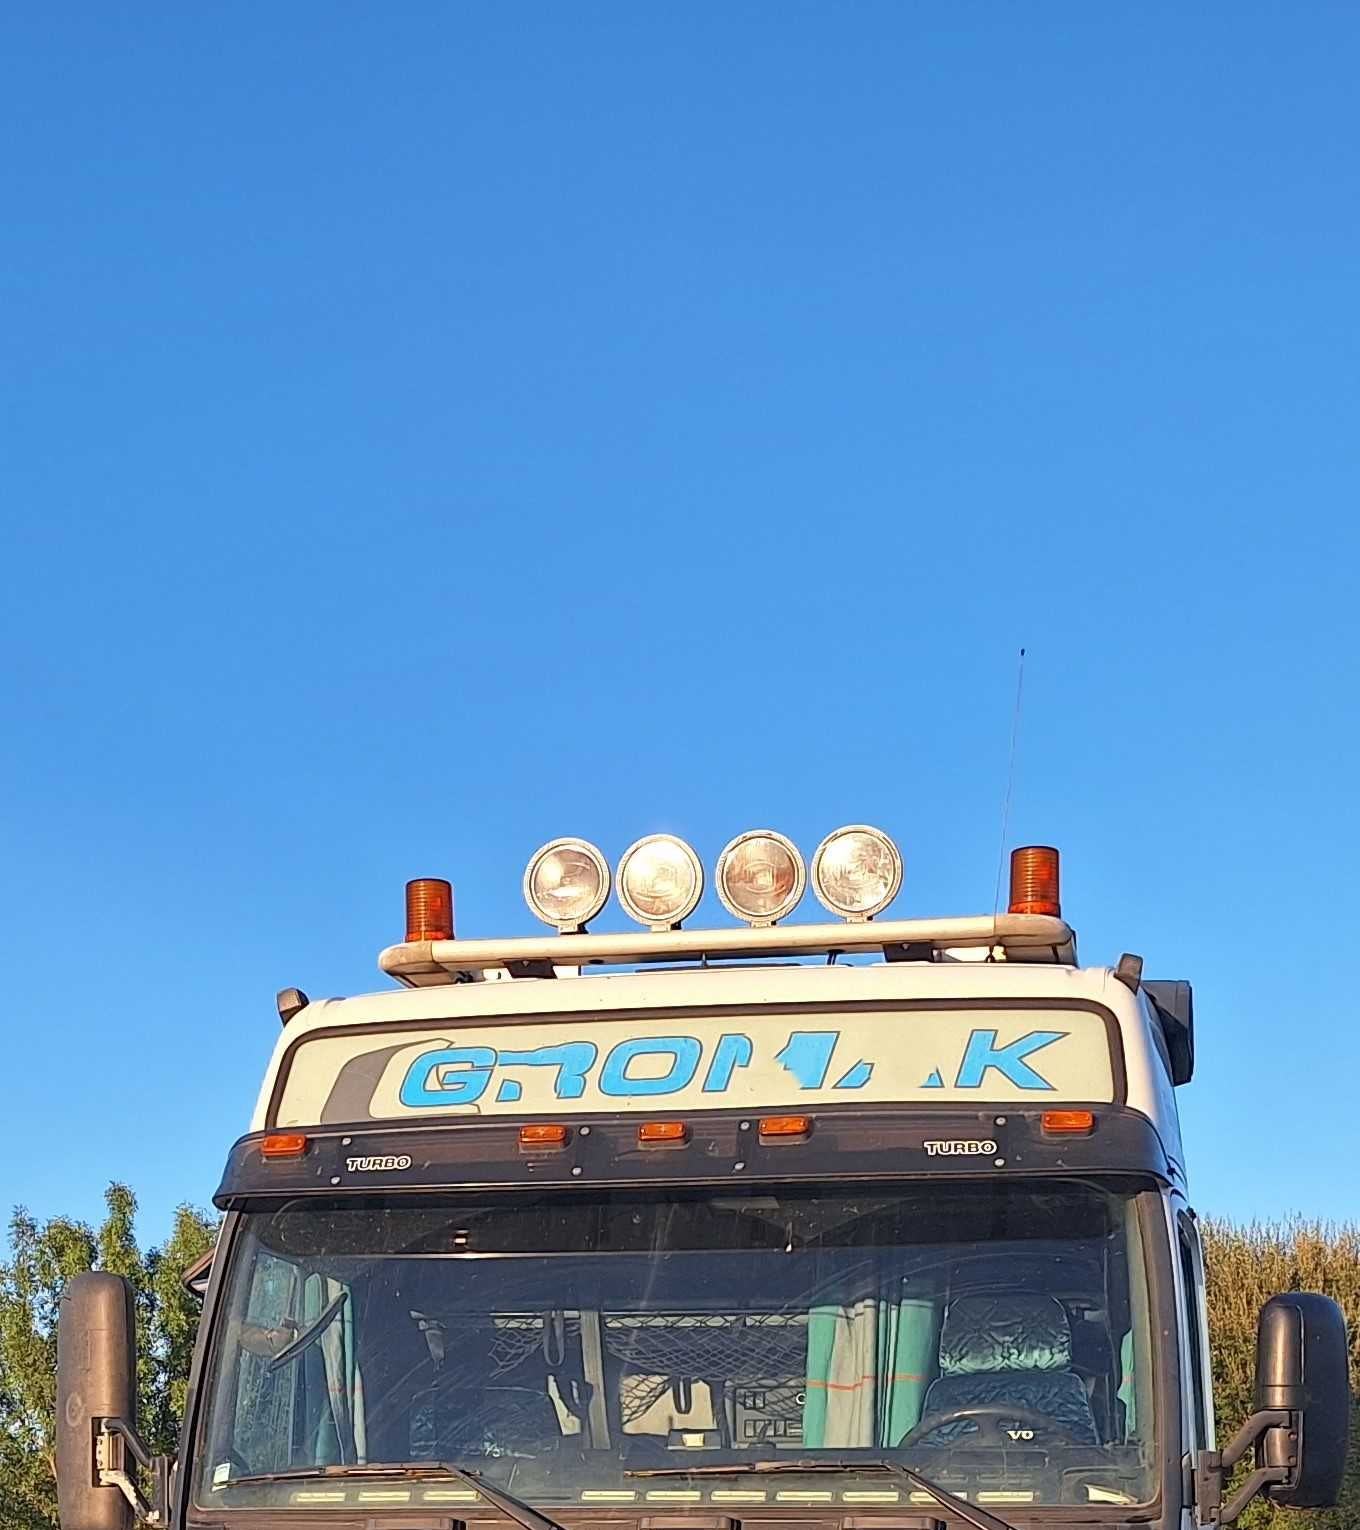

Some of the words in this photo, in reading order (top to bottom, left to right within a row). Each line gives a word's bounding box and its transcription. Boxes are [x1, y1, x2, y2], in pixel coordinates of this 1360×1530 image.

[399, 1029, 1070, 1107] GROMK
[924, 1140, 997, 1155] TURBO
[346, 1155, 412, 1171] TURBO
